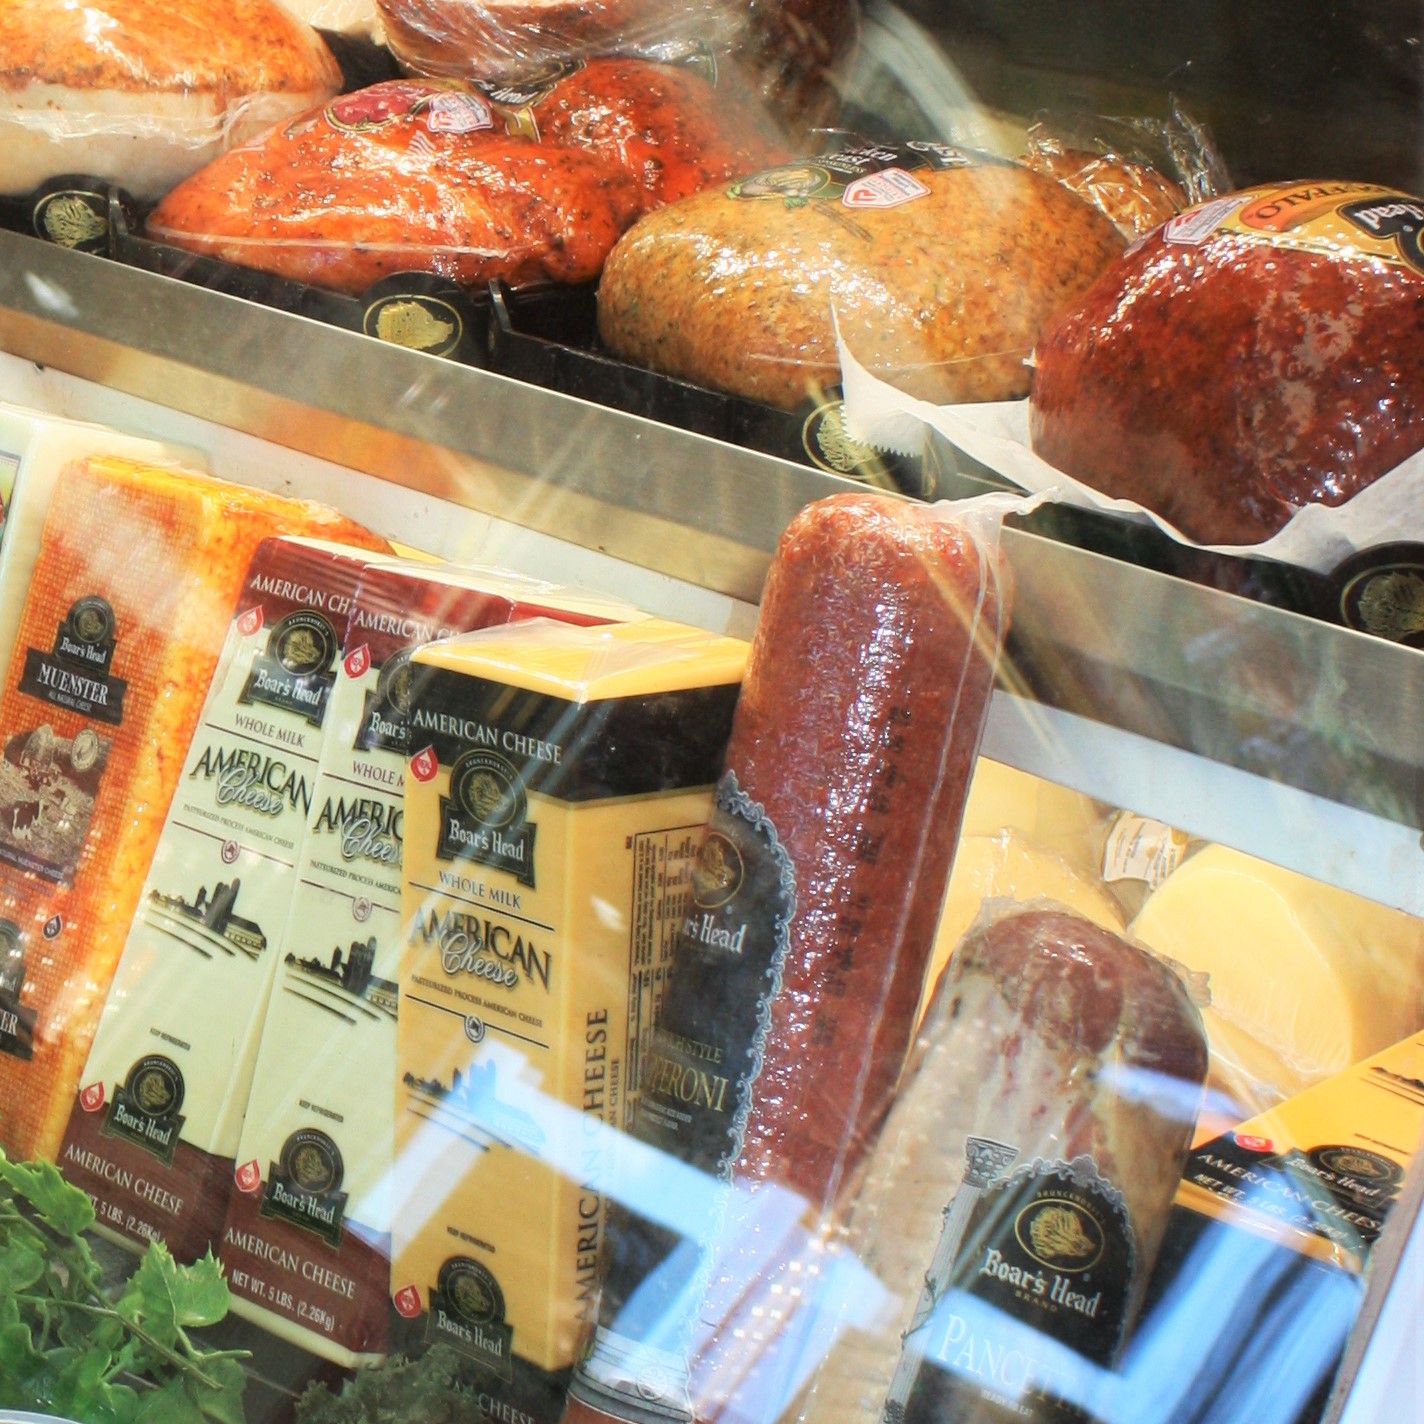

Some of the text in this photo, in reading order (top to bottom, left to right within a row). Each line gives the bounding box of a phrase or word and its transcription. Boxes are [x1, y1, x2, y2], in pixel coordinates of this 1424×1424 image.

[250, 574, 327, 613] AMERICAN
[37, 662, 109, 706] MUENSTER
[255, 669, 322, 707] Boar's Head
[233, 712, 307, 749] WHOLE MILK
[412, 708, 563, 767] AMERICAN CHEESE
[352, 760, 396, 787] WHOLE
[448, 817, 526, 864] Boar's Head
[438, 869, 523, 911] WHOLE MILK
[113, 1104, 174, 1146] Boar's Head
[63, 1143, 185, 1217] AMERICAN CHEESE
[272, 1181, 336, 1226] Boar's Head
[224, 1226, 358, 1300] AMERICAN CHEESE
[979, 1247, 1103, 1319] Boar's Head
[231, 1268, 337, 1334] NET WT. 5 LBS. (2.26Kg)
